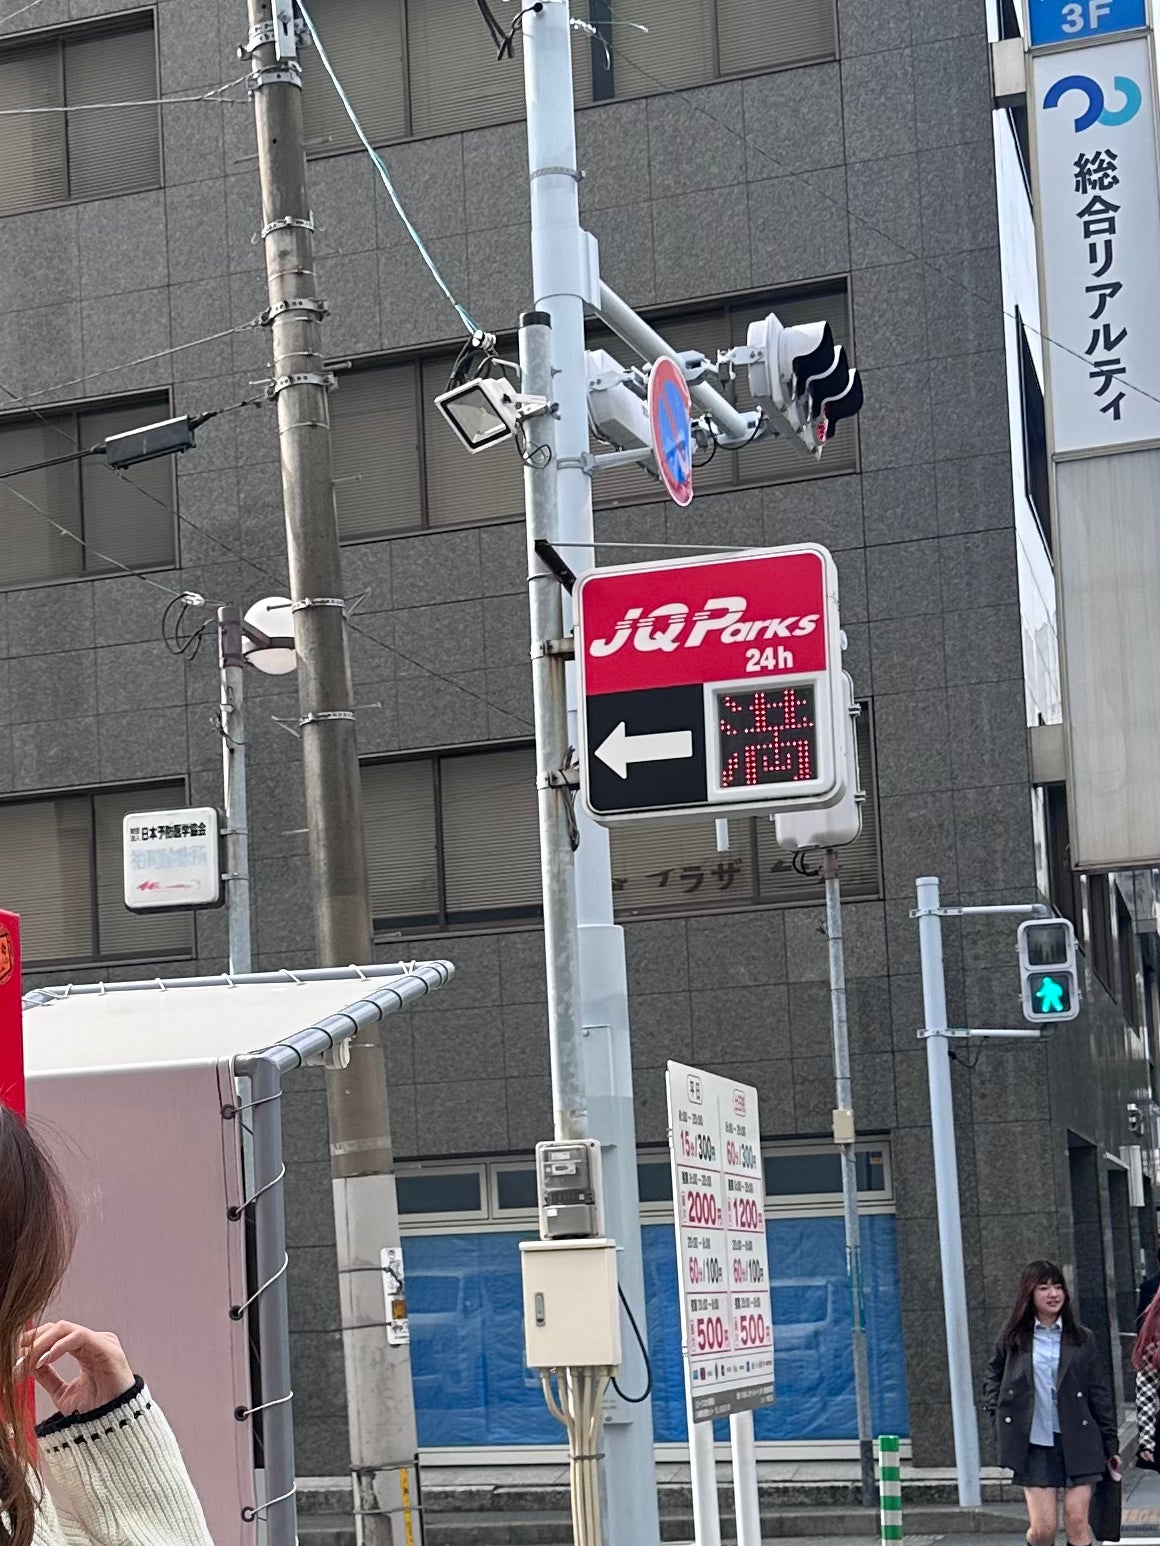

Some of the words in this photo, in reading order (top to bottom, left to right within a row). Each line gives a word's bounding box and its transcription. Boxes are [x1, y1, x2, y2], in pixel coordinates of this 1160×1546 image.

[1060, 0, 1112, 33] 3F
[1074, 149, 1127, 420] 総合リアルティ
[745, 645, 794, 673] 24h
